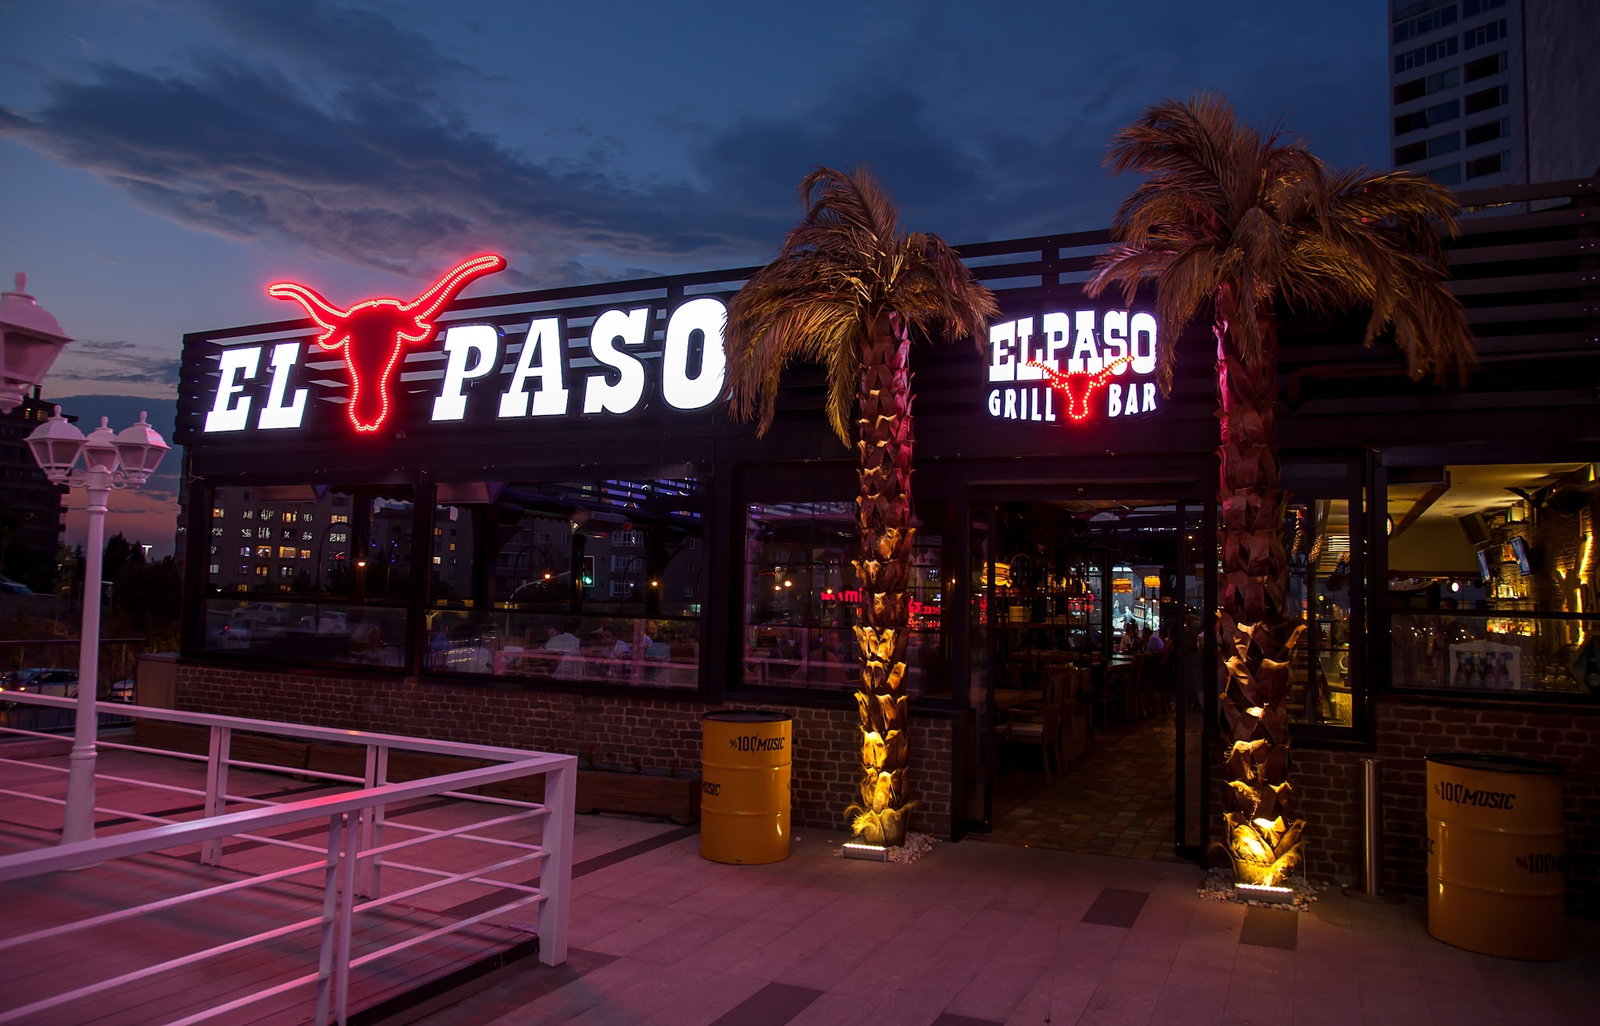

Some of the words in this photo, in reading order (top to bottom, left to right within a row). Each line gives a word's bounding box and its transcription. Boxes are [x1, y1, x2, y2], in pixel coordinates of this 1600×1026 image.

[204, 342, 308, 433] EL
[431, 298, 730, 422] PASO
[988, 387, 1056, 422] GRILL
[1108, 382, 1157, 418] BAR
